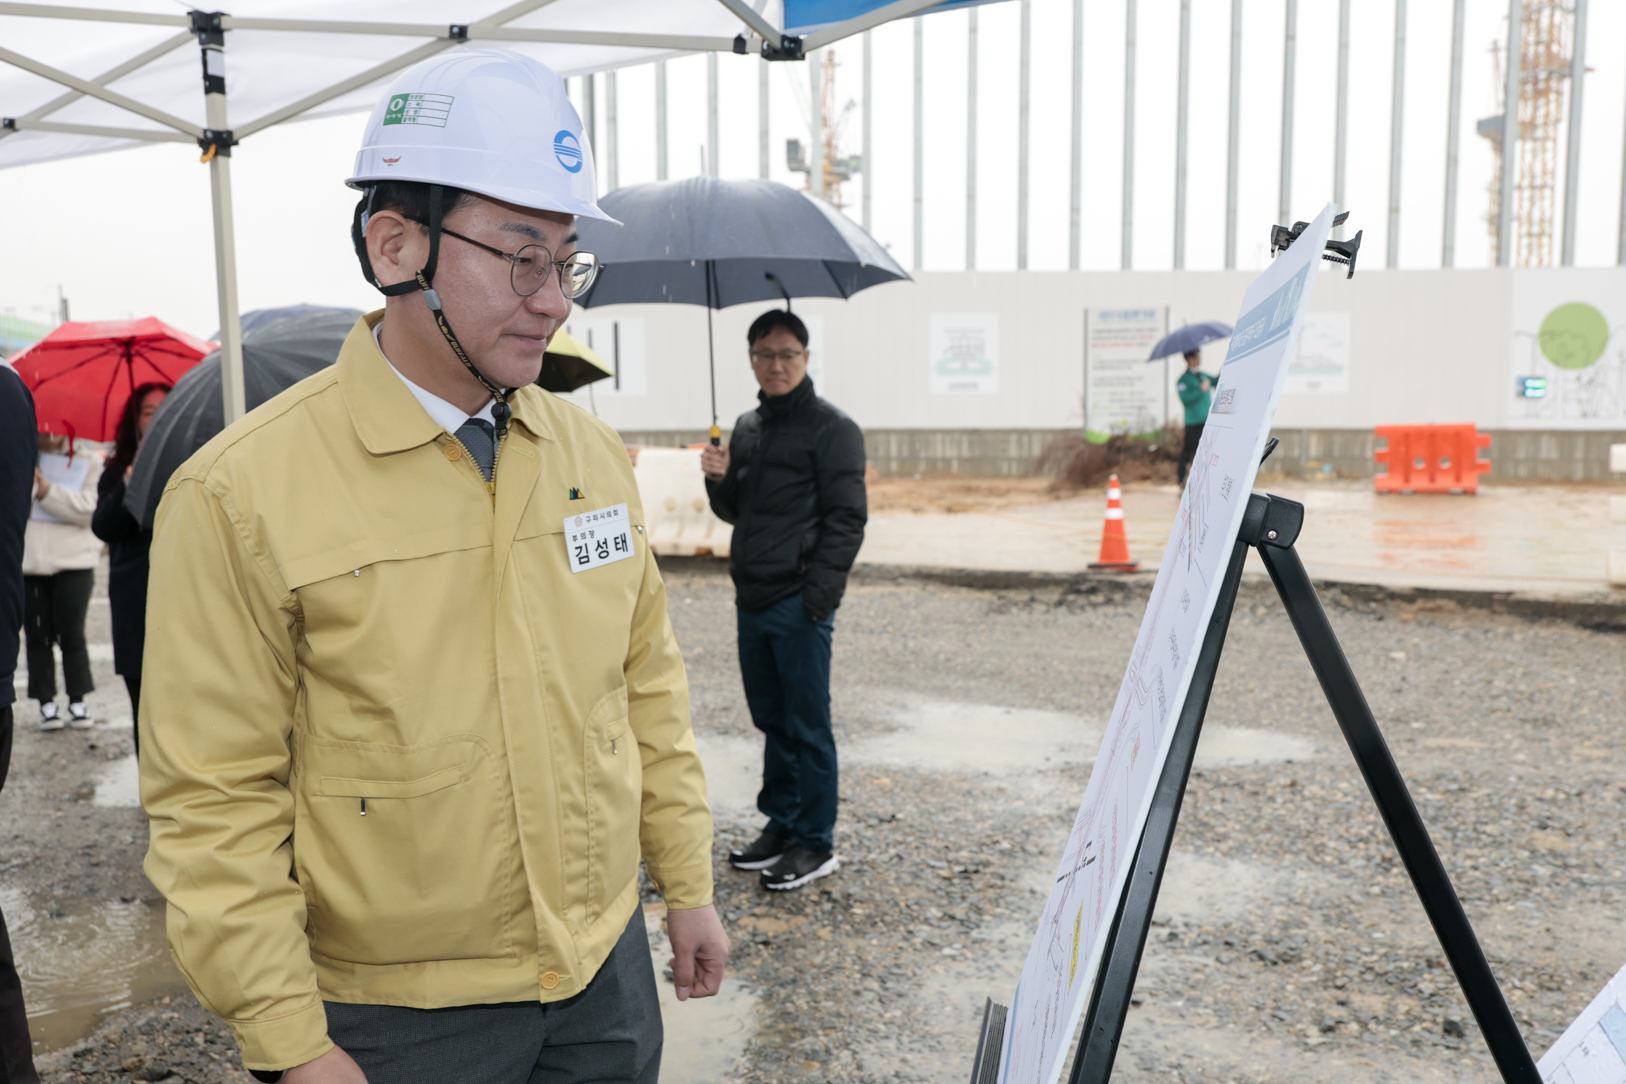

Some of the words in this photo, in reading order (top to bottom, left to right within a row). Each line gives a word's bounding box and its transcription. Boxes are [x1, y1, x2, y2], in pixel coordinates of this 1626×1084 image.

[450, 341, 472, 367] BUFFALO
[585, 509, 619, 523] 구리시의회
[572, 530, 595, 543] 부의장
[574, 532, 629, 565] 김성태
